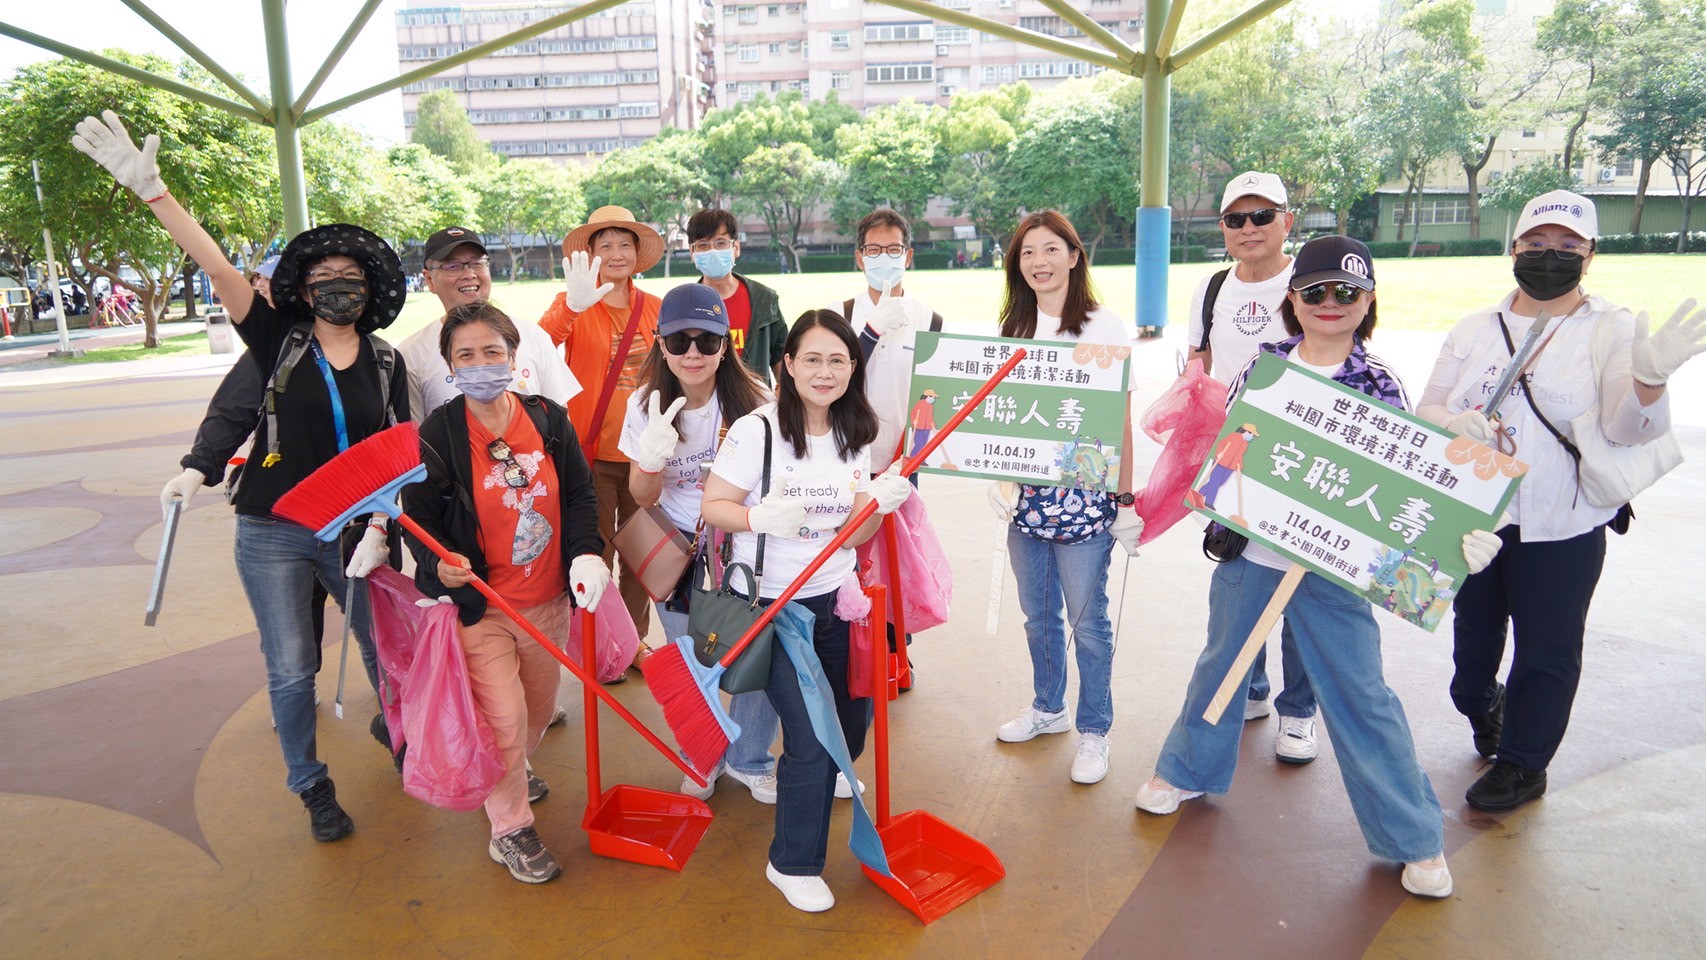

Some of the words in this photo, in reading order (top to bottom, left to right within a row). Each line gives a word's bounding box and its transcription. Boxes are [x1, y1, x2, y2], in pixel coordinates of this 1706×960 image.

[1531, 204, 1568, 217] Allianz
[1232, 315, 1272, 324] HILFIGER
[983, 345, 1058, 362] 世界球日
[1333, 398, 1429, 449] 世界地球日
[983, 443, 1036, 459] 114.04.19
[1284, 399, 1459, 490] 桃園市環境清潔活動
[680, 469, 696, 478] for
[805, 485, 839, 499] ready
[1269, 440, 1436, 545] 安聯人壽
[815, 503, 834, 514] the
[1285, 511, 1351, 551] 114.04.19
[1258, 520, 1360, 579] @忠孝公園周圍街道
